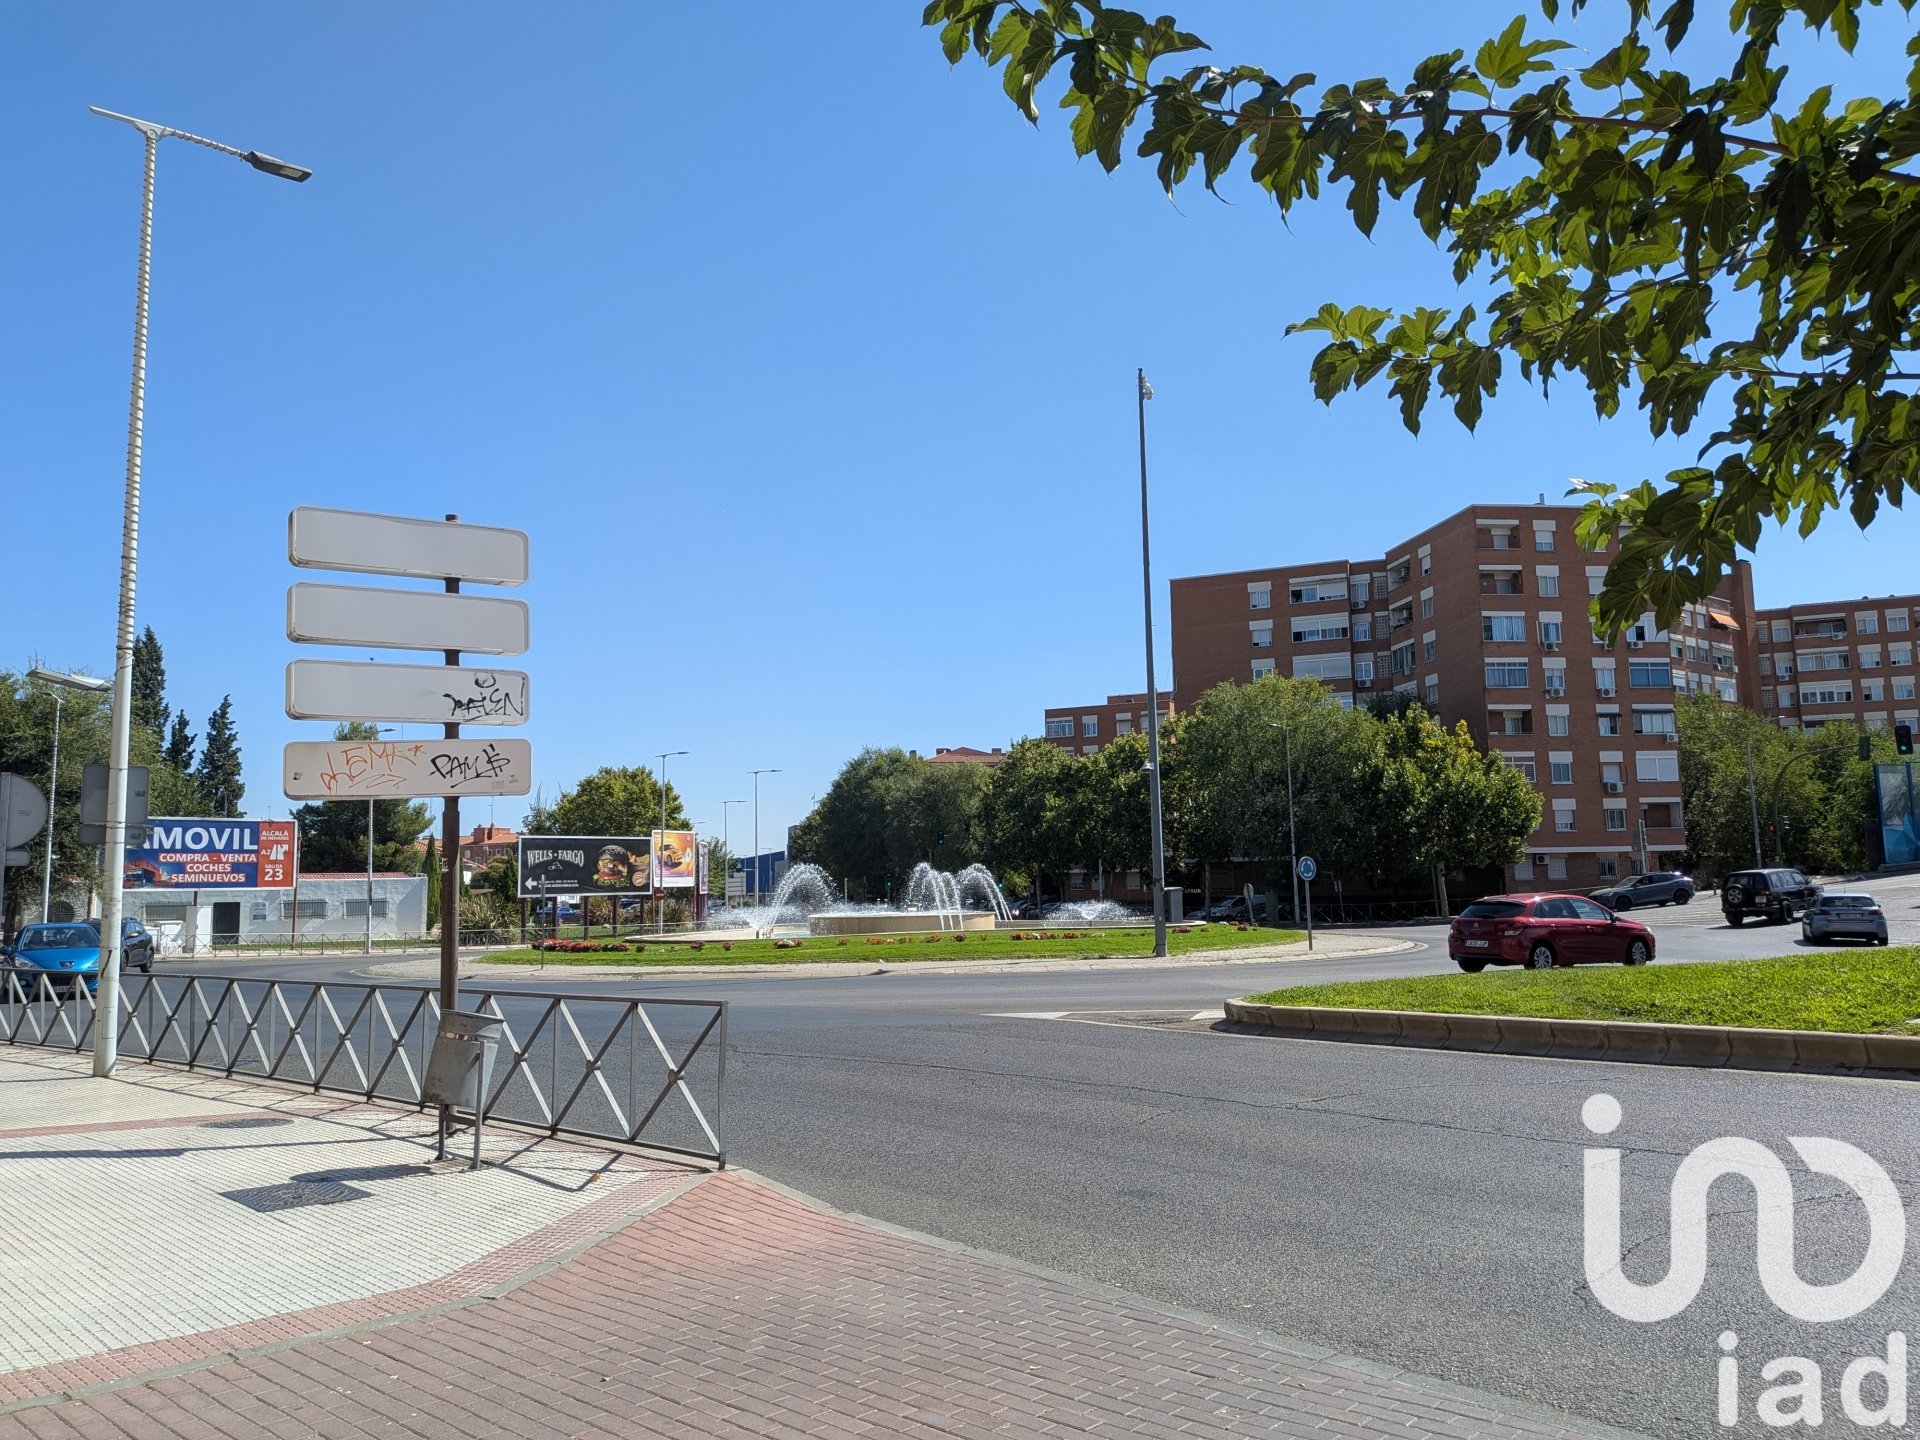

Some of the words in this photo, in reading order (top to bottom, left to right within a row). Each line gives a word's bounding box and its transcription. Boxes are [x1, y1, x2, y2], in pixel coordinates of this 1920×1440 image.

[160, 853, 209, 862] COMPRA
[220, 853, 257, 862] VENTA
[527, 850, 553, 869] WELLS
[558, 850, 584, 867] FARGO
[186, 863, 231, 872] COCHES
[171, 873, 246, 883] SEMINUEVOS
[264, 869, 284, 881] 23
